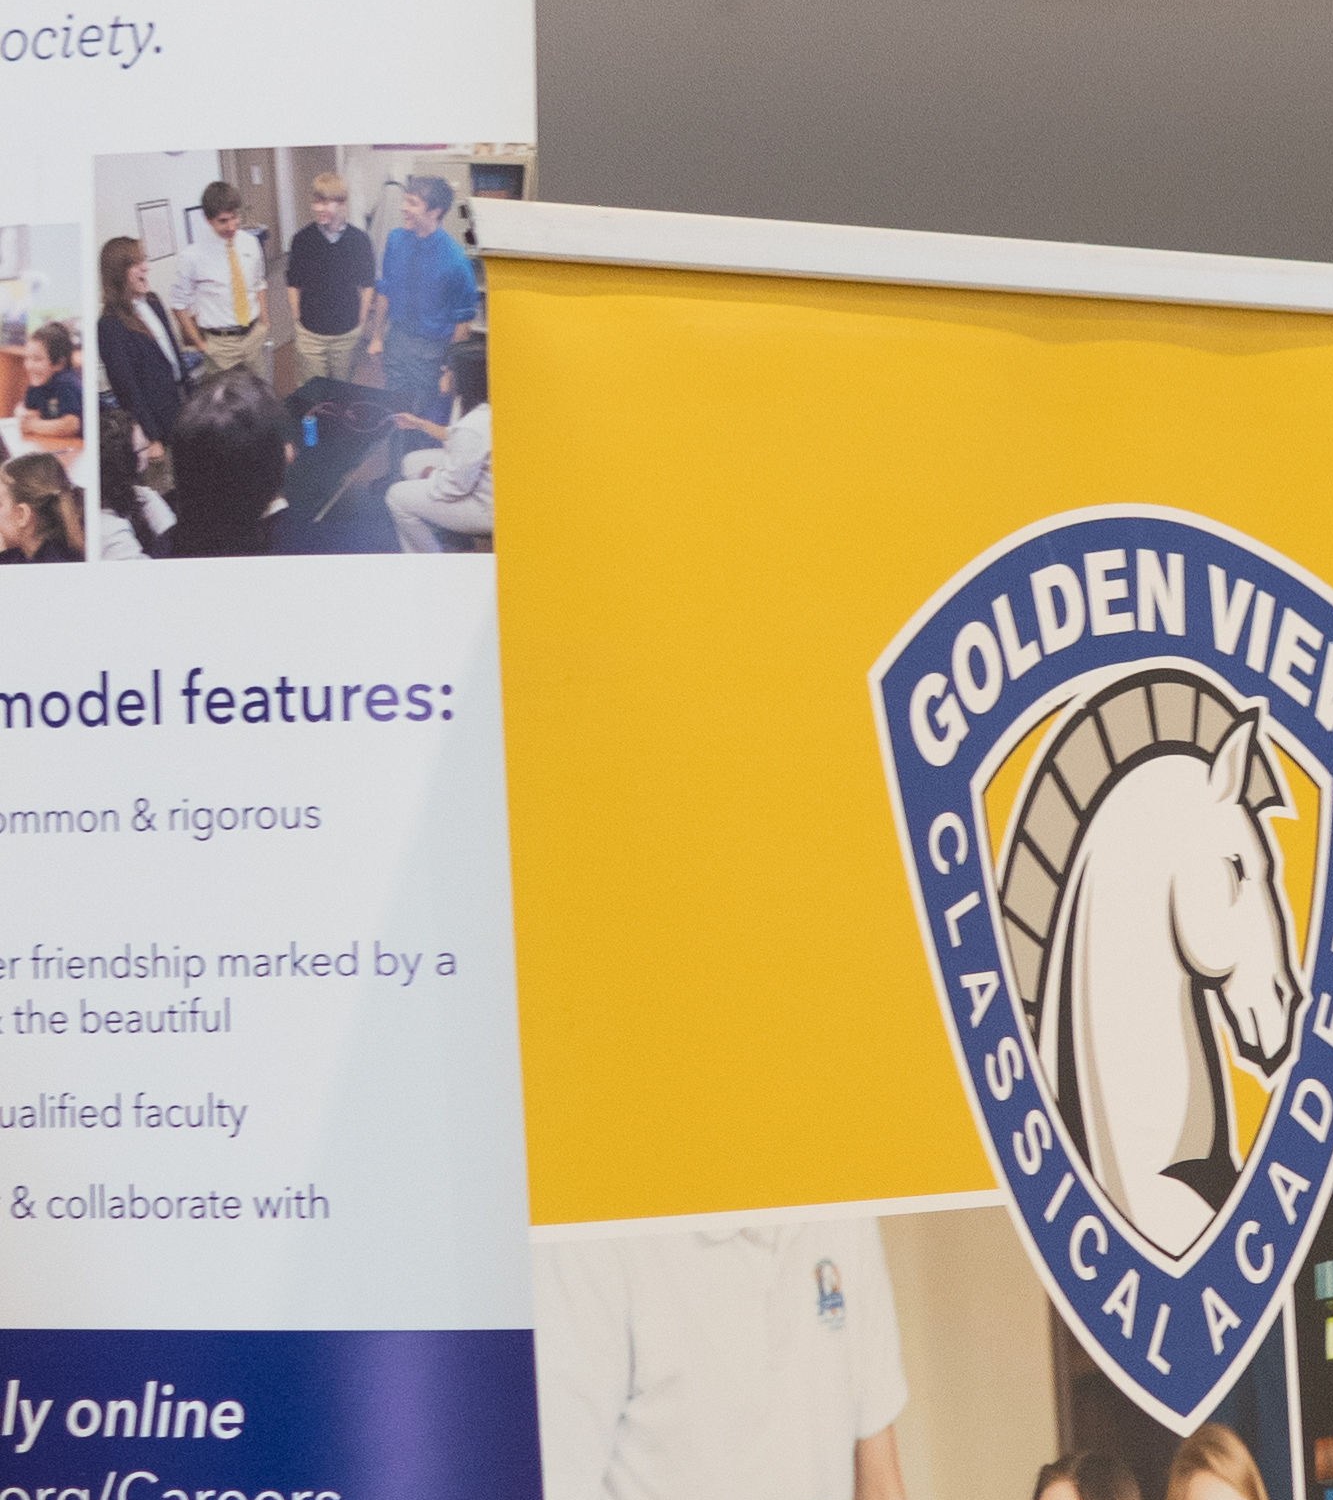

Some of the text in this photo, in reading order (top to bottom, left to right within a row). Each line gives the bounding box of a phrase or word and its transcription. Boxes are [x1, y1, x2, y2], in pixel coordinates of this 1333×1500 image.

[0, 13, 163, 70] ociety.
[908, 547, 1187, 768] GOLDEN
[0, 666, 455, 730] model features:
[130, 797, 158, 832] &
[167, 798, 323, 842] rigorous
[29, 941, 207, 989] friendship
[217, 940, 360, 978] marked
[372, 939, 424, 987] by
[434, 951, 458, 977] a
[12, 996, 232, 1035] the beautiful
[0, 1091, 249, 1139] ualified faculty
[928, 810, 1173, 1376] CLASSICAL
[9, 1182, 331, 1219] & collaborate with
[0, 1379, 246, 1453] ly online
